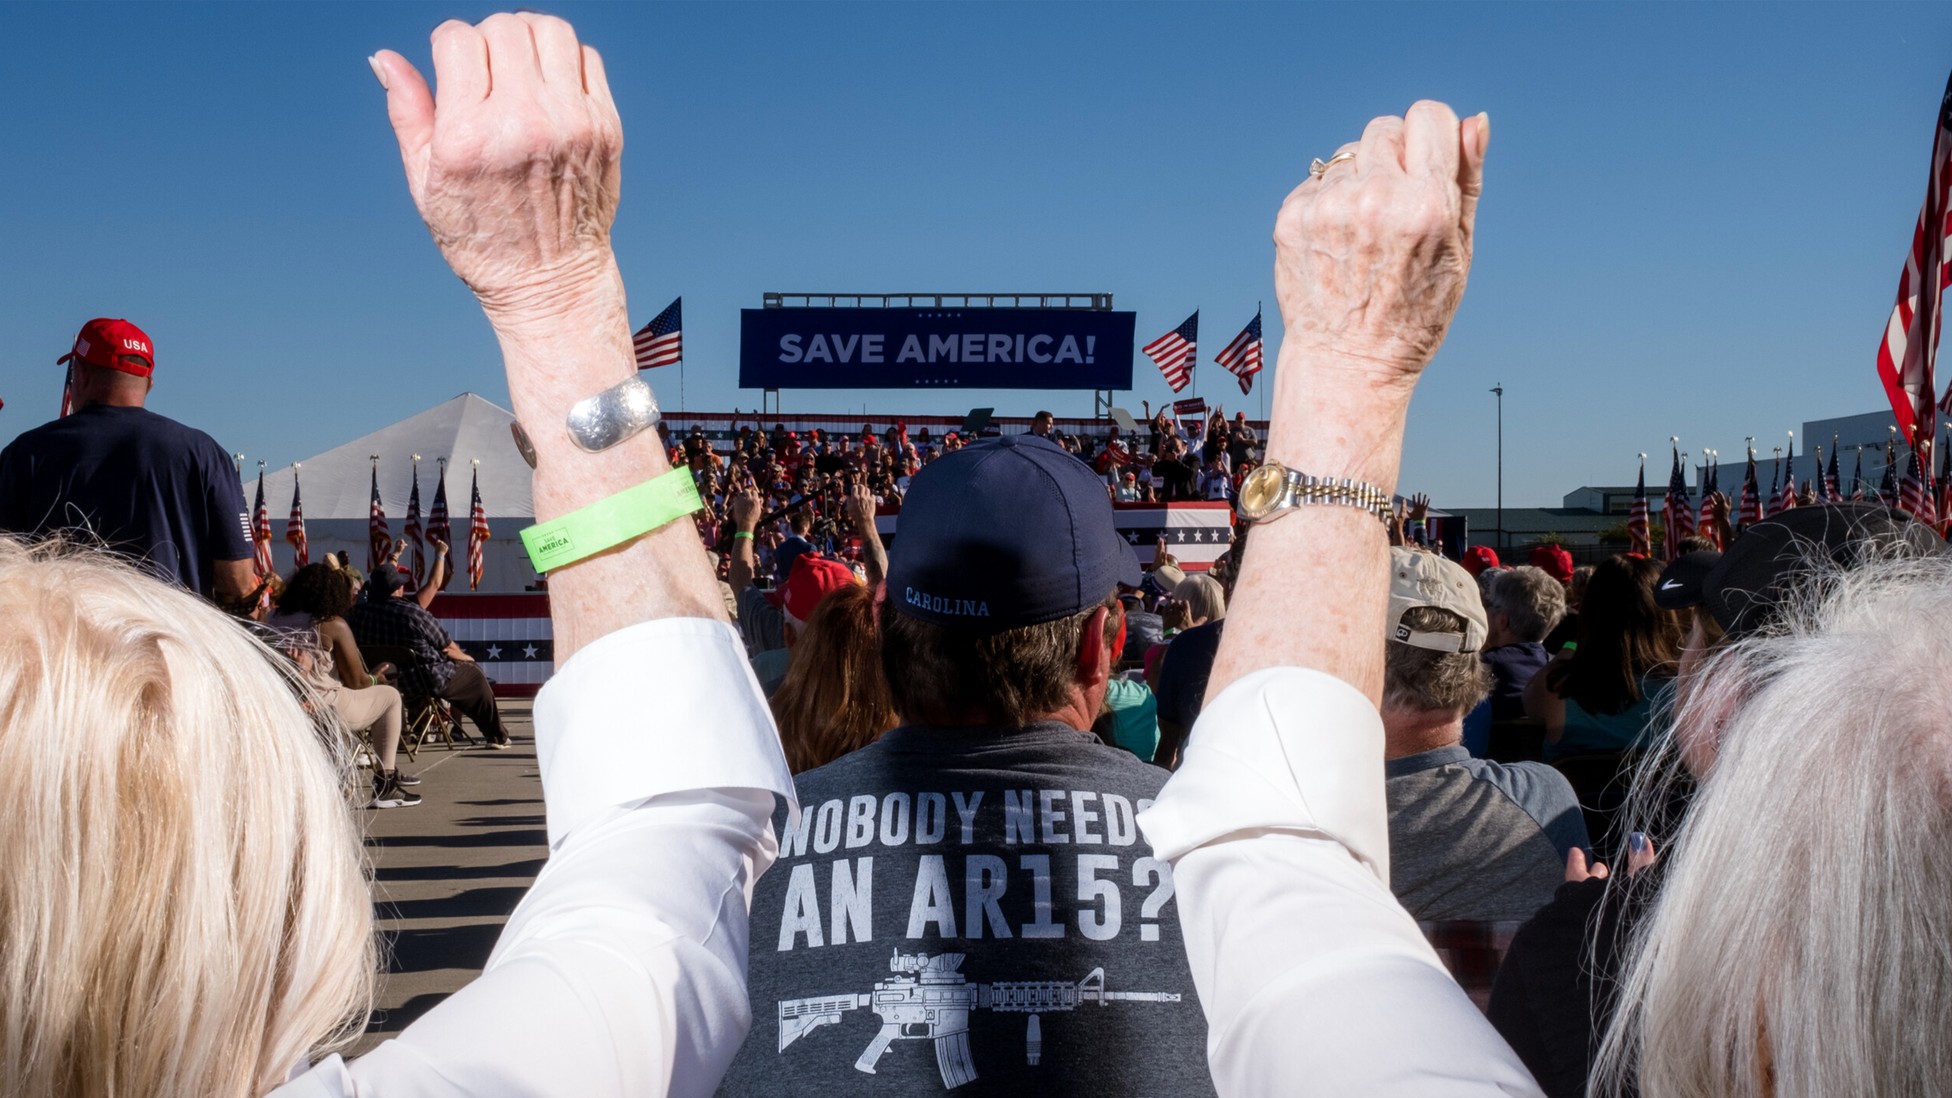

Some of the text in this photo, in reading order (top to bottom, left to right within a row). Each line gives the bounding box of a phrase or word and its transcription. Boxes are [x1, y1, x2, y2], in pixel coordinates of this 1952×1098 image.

[123, 338, 148, 353] USA
[778, 333, 1096, 364] SAVE AMERICA!
[538, 537, 569, 553] AMERICA
[905, 586, 990, 617] CAROLINA
[780, 790, 985, 859] NOBODY
[777, 854, 1175, 952] AN AR15?
